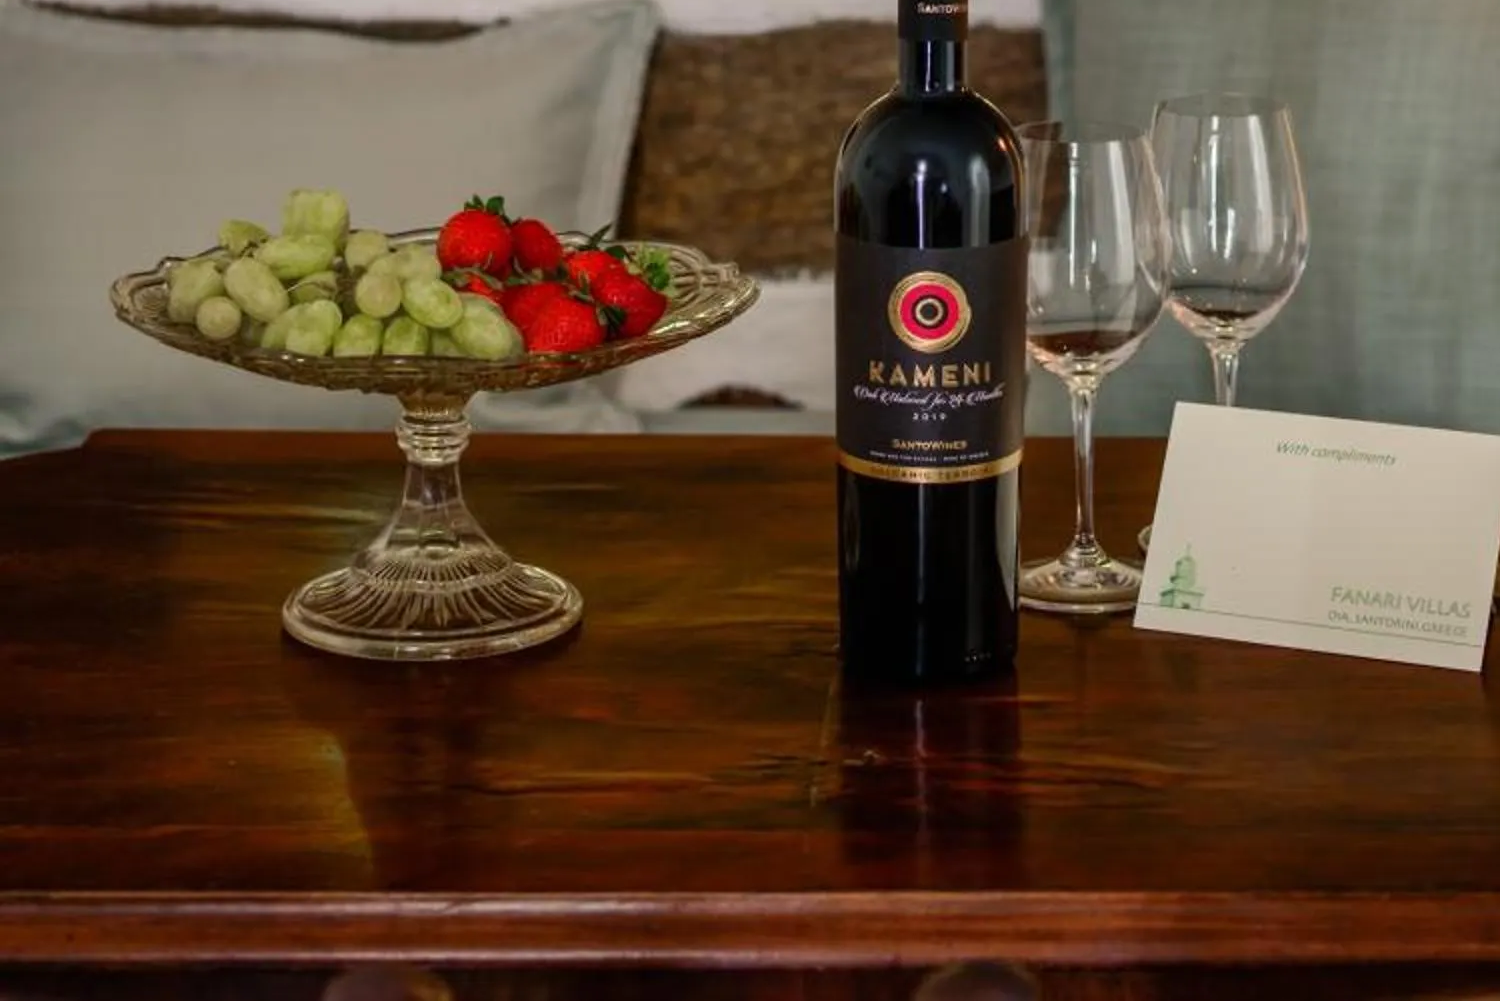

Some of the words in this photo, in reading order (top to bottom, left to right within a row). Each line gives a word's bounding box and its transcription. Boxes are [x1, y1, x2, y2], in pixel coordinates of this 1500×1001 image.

[868, 360, 991, 388] KAMENI
[1277, 440, 1310, 457] With
[1311, 447, 1396, 466] compliments
[1330, 586, 1402, 610] FANARI
[1405, 595, 1471, 619] VILLAS
